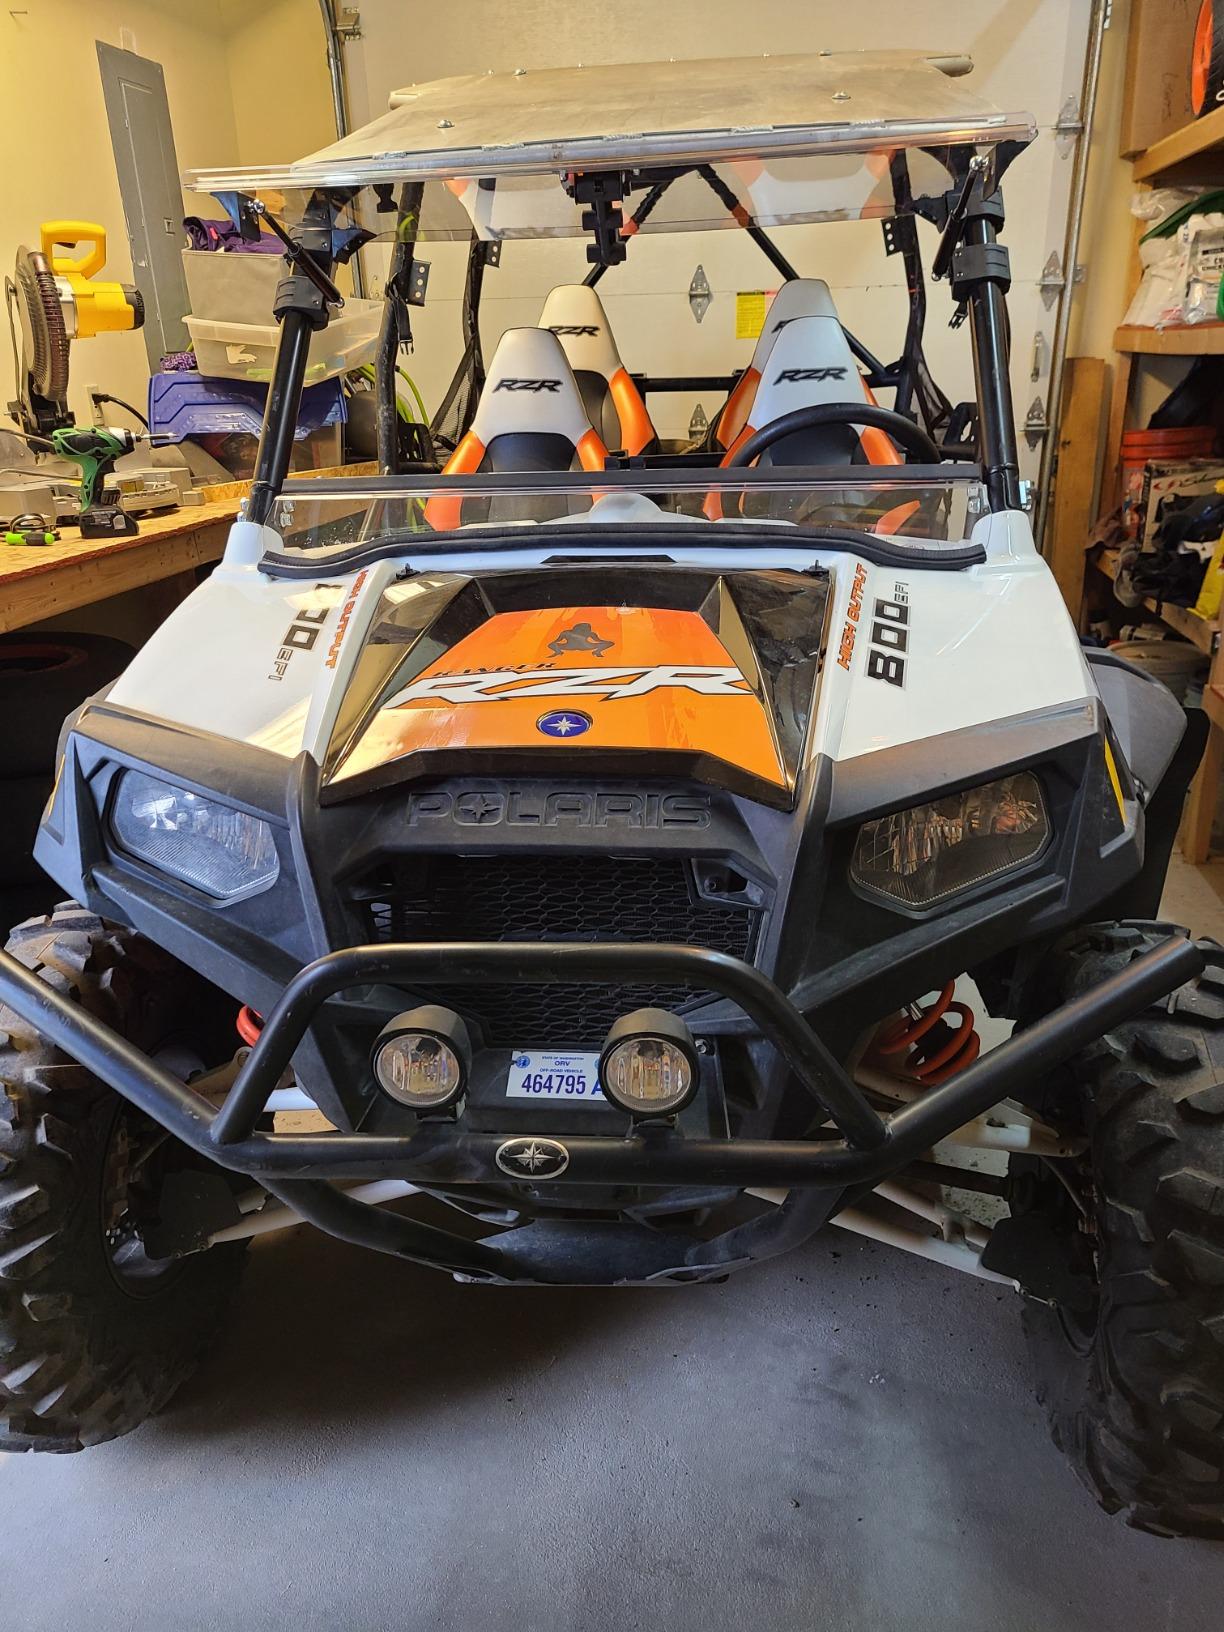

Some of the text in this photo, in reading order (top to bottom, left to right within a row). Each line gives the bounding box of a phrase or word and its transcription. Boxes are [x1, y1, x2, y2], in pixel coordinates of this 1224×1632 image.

[493, 379, 563, 394] RZR
[773, 367, 848, 387] RZR
[894, 581, 910, 605] EFI
[837, 563, 868, 671] HIGH OUTPUT
[868, 599, 908, 685] 800
[268, 648, 293, 682] EFI
[380, 665, 755, 710] RZR
[407, 791, 712, 831] POLARIS
[522, 1074, 586, 1094] 464795
